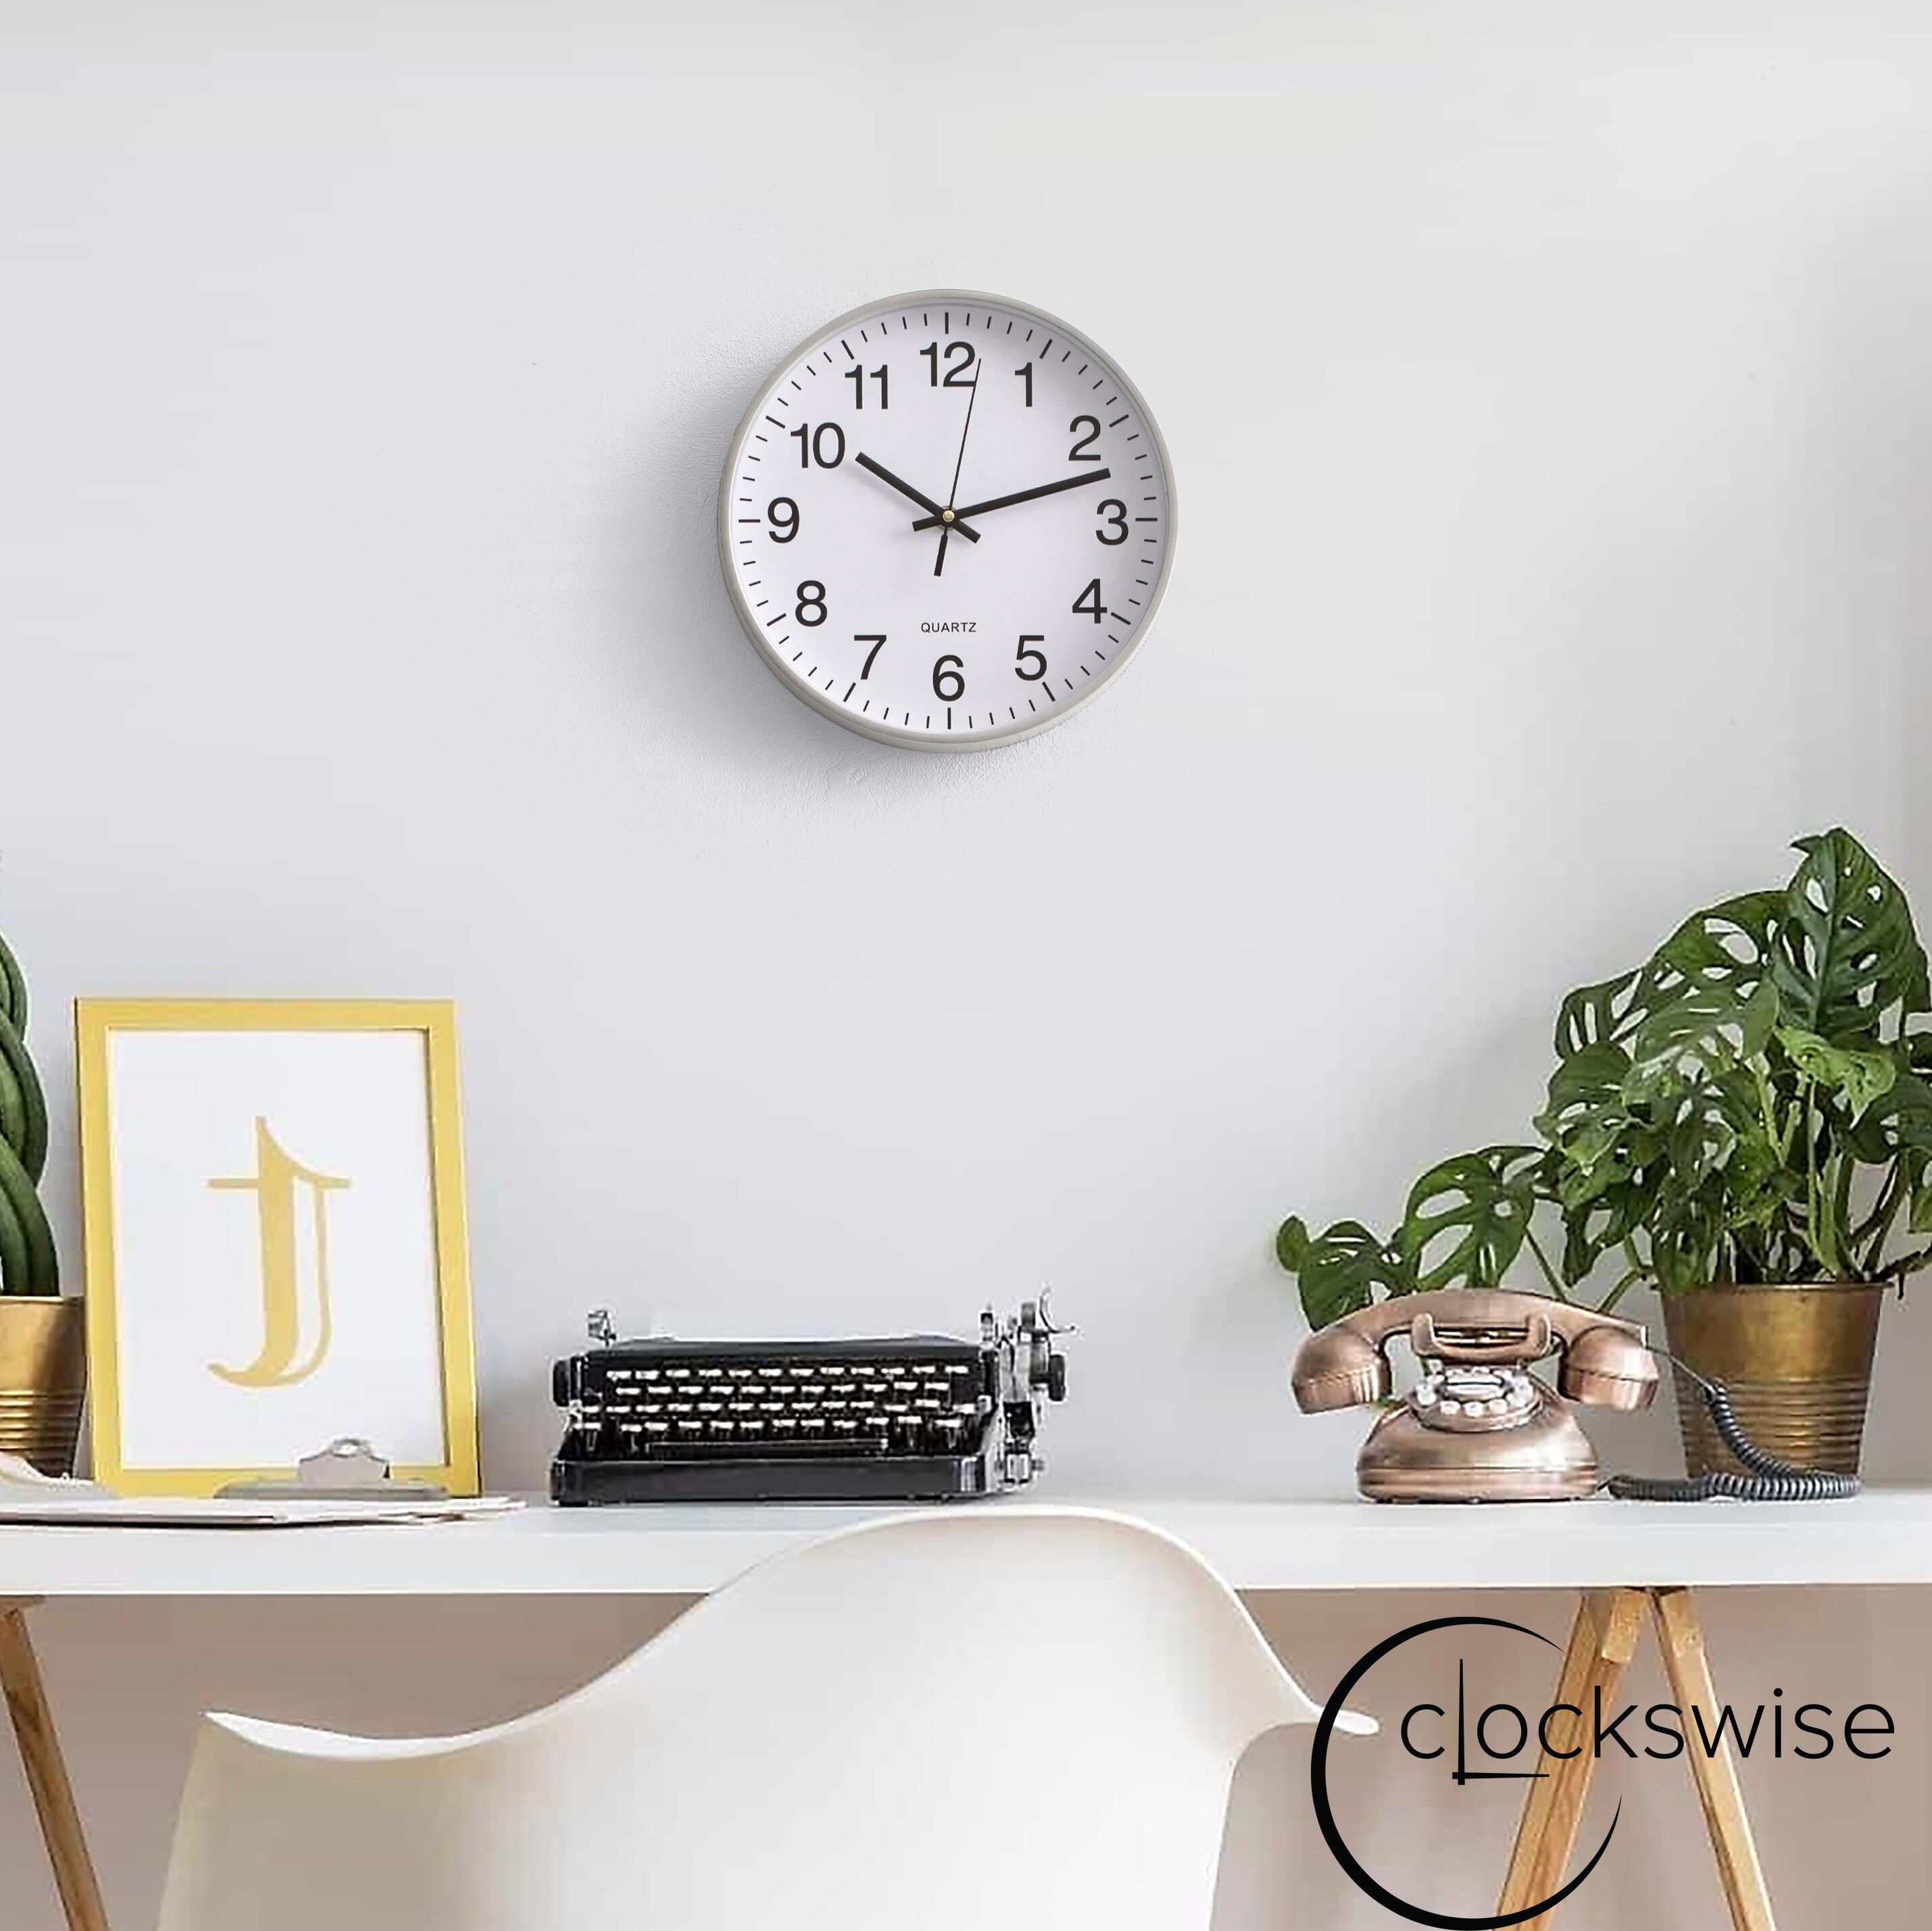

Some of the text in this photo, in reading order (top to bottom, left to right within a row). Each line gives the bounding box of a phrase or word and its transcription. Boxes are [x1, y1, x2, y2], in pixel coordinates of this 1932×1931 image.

[920, 341, 976, 387] 12
[1015, 363, 1032, 407] 1
[845, 365, 887, 409] 11
[791, 422, 845, 468] 10
[1069, 416, 1101, 461] 2
[768, 497, 799, 543] 9
[1096, 499, 1129, 545] 3
[795, 580, 827, 626] 8
[1072, 579, 1107, 624] 4
[920, 622, 977, 634] QUARTZ
[854, 635, 887, 680] 7
[933, 655, 964, 701] 6
[1015, 635, 1047, 680] 5
